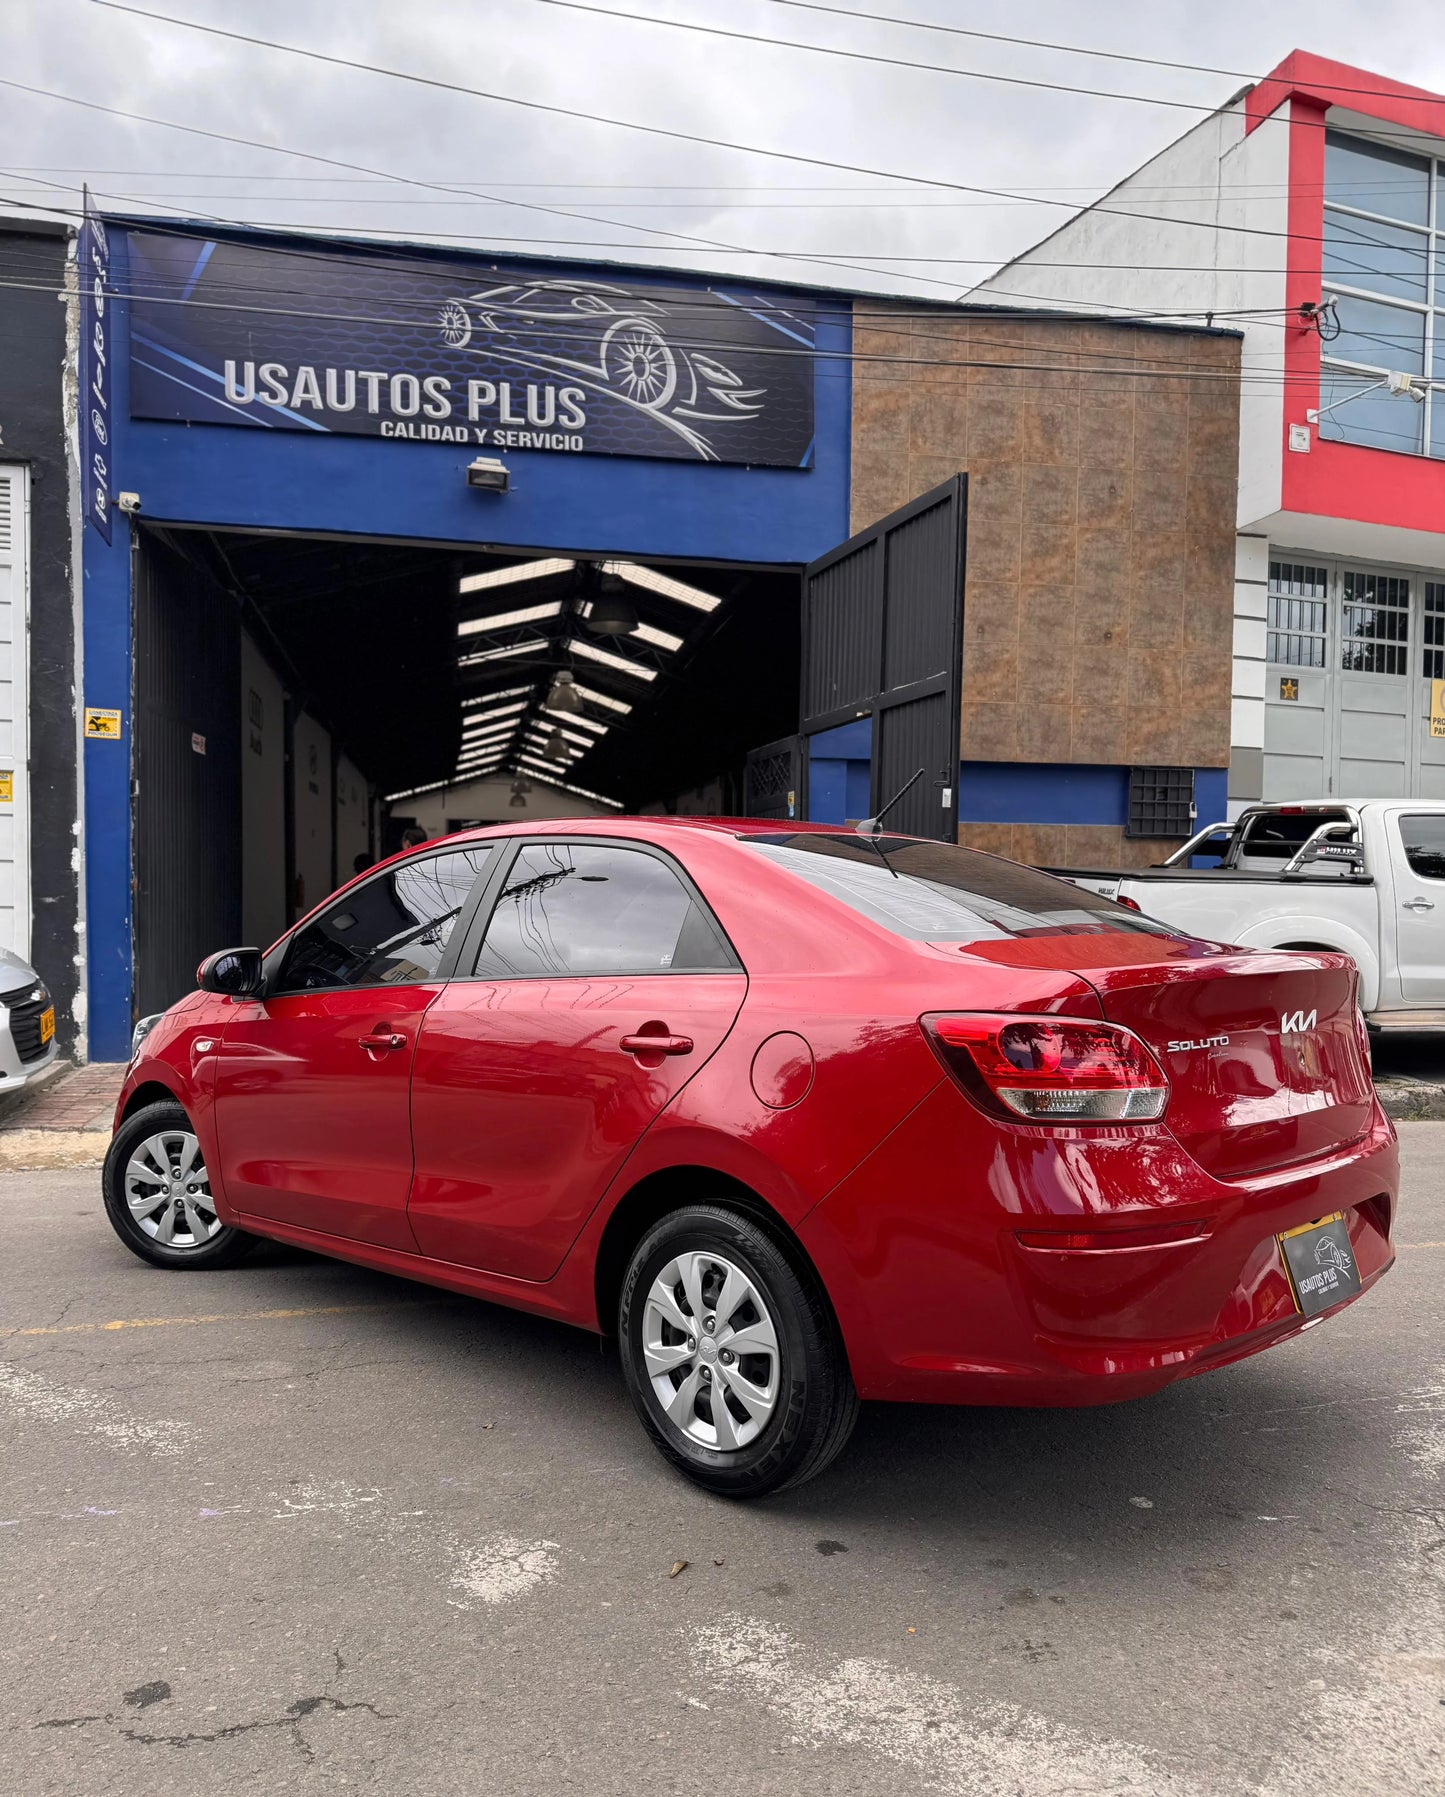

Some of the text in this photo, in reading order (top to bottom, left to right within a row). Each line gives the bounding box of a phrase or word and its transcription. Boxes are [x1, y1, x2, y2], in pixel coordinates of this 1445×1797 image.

[224, 359, 587, 430] USAUTOS PLUS
[380, 421, 584, 451] CALIDAD Y SERVICIO
[1281, 1009, 1317, 1034] KIA
[1167, 1036, 1230, 1052] SOLUTO
